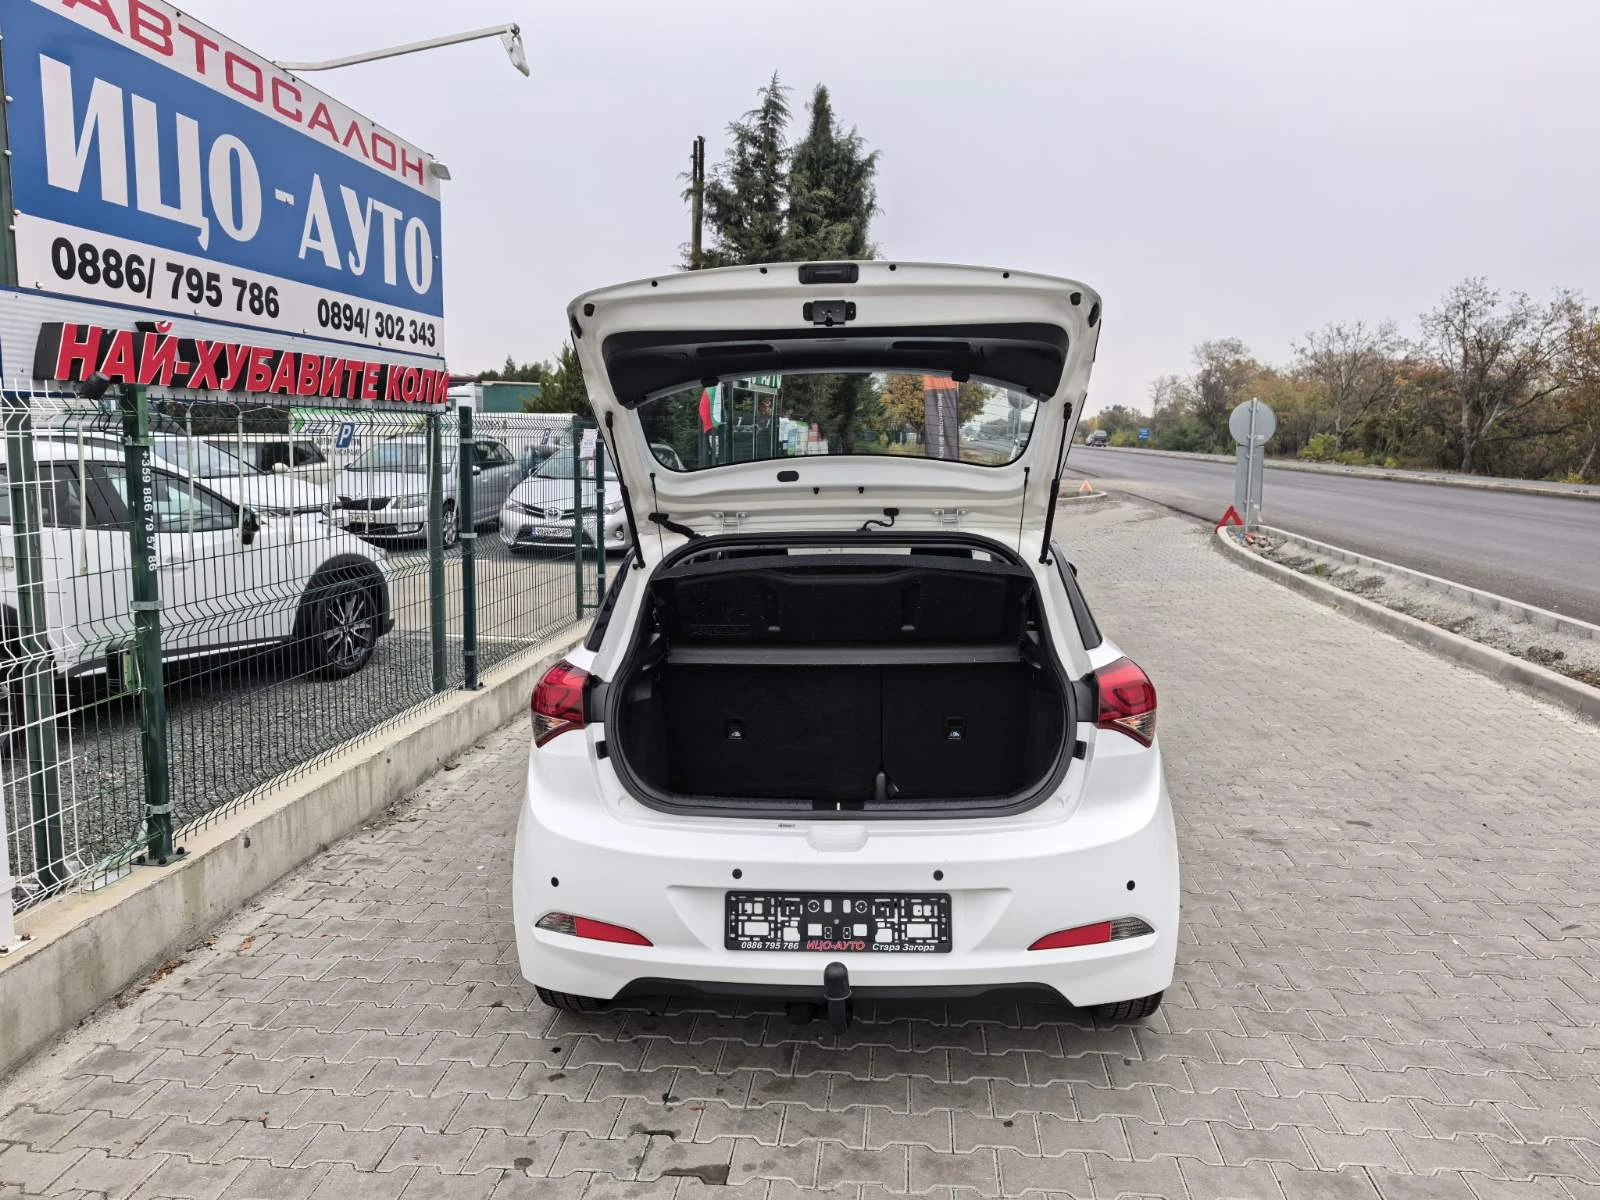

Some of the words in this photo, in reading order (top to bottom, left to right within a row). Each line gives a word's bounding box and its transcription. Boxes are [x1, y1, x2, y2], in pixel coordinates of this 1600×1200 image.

[51, 237, 156, 299] 0886/
[166, 262, 222, 308] 795
[232, 277, 280, 319] 786
[317, 298, 370, 338] 0894/
[374, 311, 405, 342] 302
[409, 319, 436, 348] 343
[385, 363, 450, 405] КОЛИ
[338, 424, 352, 446] P
[141, 450, 151, 483] +359
[143, 487, 153, 512] 886
[144, 516, 154, 531] 79
[146, 535, 156, 552] 57
[147, 555, 158, 572] 86
[741, 941, 763, 949] 0886
[765, 941, 781, 949] 795
[783, 942, 799, 950] 786
[806, 940, 866, 952] ИЦО-АУТО
[872, 943, 900, 951] Стара
[902, 943, 935, 951] Загора
